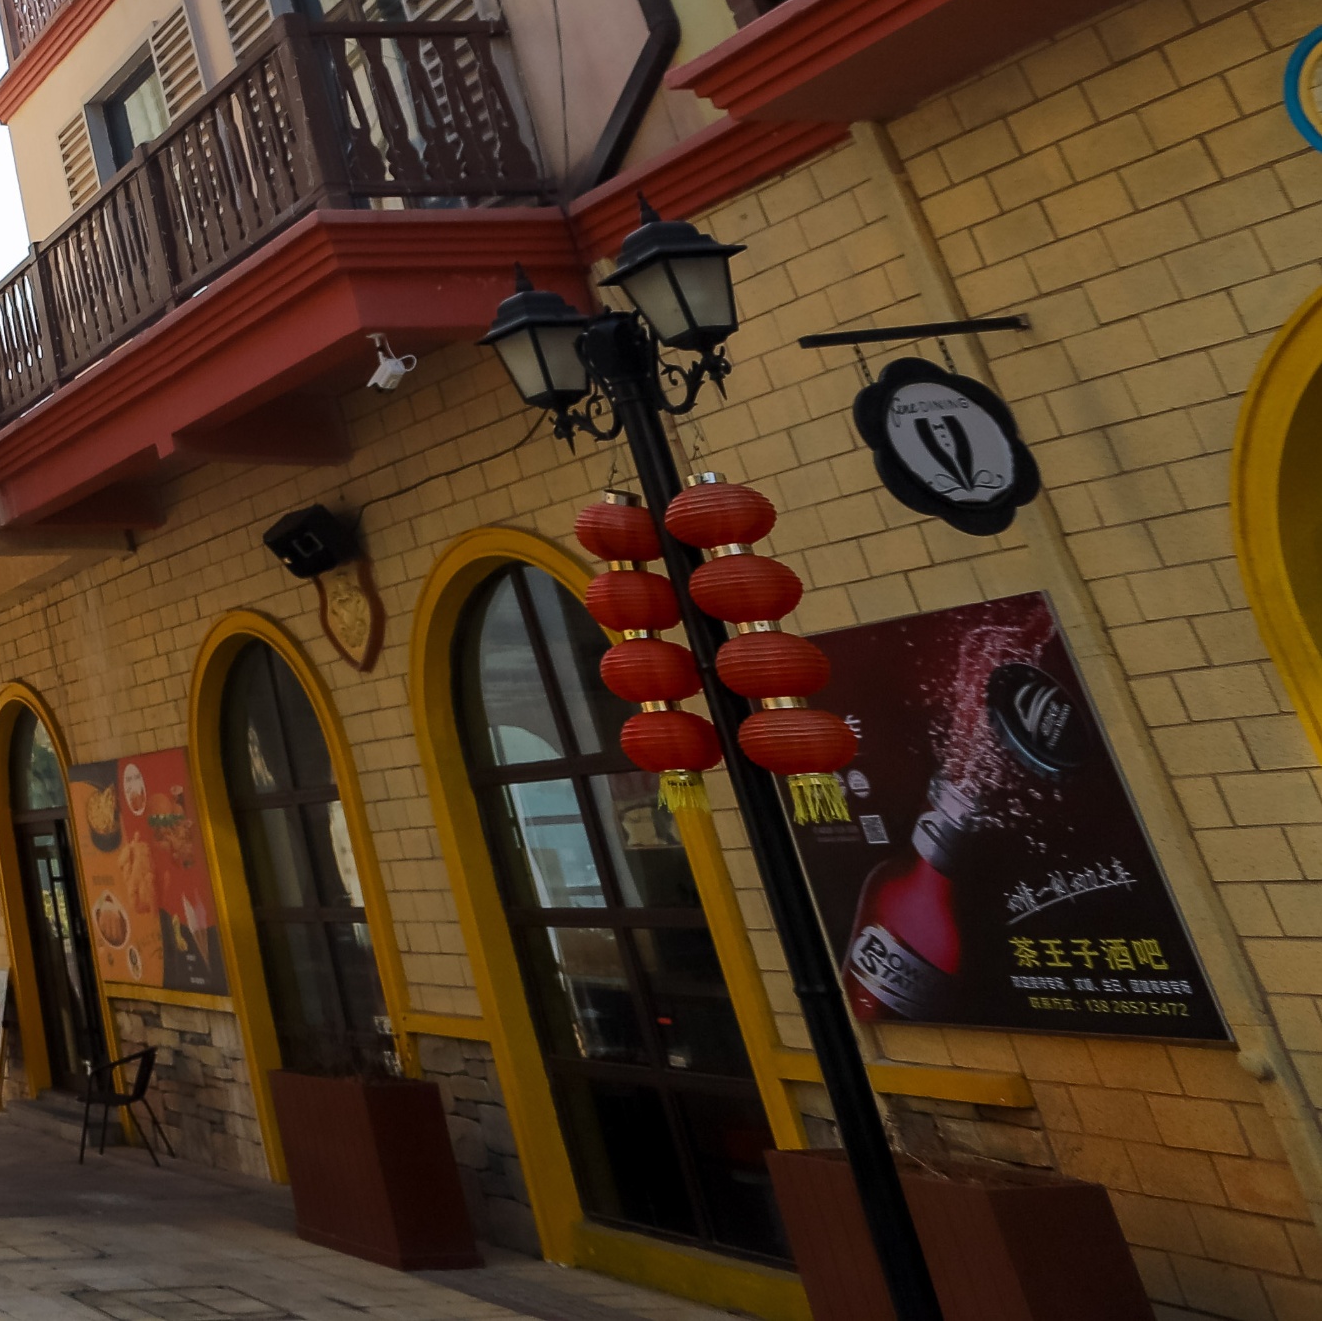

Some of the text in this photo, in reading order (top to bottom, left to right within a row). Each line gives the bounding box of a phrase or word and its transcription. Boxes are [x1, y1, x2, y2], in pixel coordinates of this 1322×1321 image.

[1008, 936, 1169, 971] 茶王子酒吧
[1084, 998, 1111, 1013] 138
[1112, 1000, 1149, 1015] 2652
[1148, 1001, 1191, 1017] 5472
